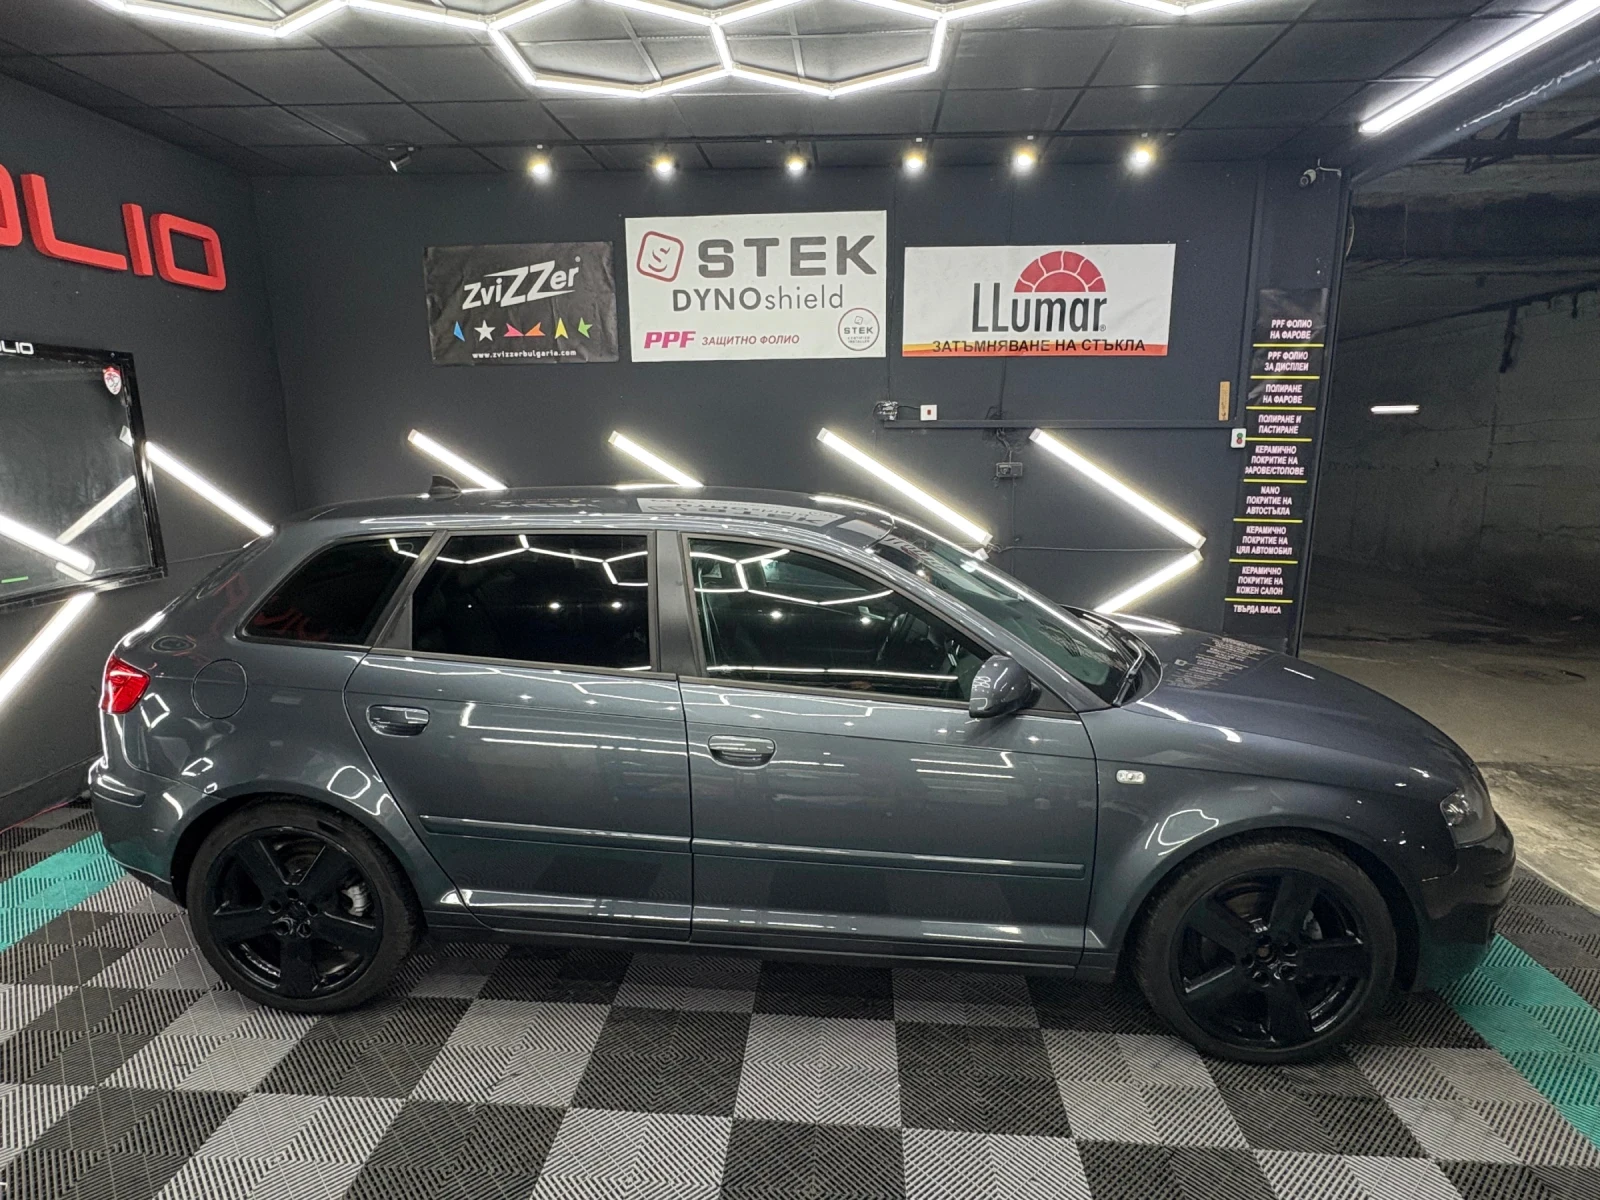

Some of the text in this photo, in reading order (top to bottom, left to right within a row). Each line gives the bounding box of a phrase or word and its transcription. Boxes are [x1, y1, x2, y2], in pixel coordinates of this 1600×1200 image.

[0, 164, 226, 290] LIO
[698, 235, 877, 278] STEK
[672, 284, 843, 311] DYNOshield
[1271, 319, 1312, 329] PPF ФОЛИО
[1270, 330, 1311, 339] НА ФАРОВЕ
[644, 331, 800, 348] PPF ЗАЩИТНО ФОЛИО
[0, 340, 34, 355] LIO
[933, 338, 1146, 352] ЗАТЪМНЯВАНЕ НА СТЪКЛА
[472, 350, 577, 359] www.zvizzerbulgaria.com
[1267, 351, 1308, 360] PPF ФОЛИО
[1264, 362, 1274, 371] ЗА
[1265, 384, 1302, 393] ПОЛИРАНЕ
[1262, 395, 1303, 404] НА ФАРОВЕ
[1258, 414, 1302, 424] ПОЛИРАНЕ И
[1258, 425, 1299, 434] ПАСТИРАНЕ
[1255, 445, 1297, 455] КЕРАМИЧНО
[1251, 455, 1298, 465] ПОКРИТИЕ НА
[1246, 496, 1292, 505] ПОКРИТИЕ НА
[1246, 506, 1290, 515] АВТОСТЪКЛА
[1246, 525, 1287, 534] КЕРАМИЧНО
[1242, 536, 1288, 545] ПОКРИТИЕ НА
[1251, 546, 1293, 555] АВТОМОБИЛ
[1241, 566, 1282, 575] КЕРАМИЧНО
[1237, 576, 1283, 585] ПОКРИТИЕ НА
[1236, 586, 1283, 595] КОЖЕН САЛОН
[1233, 604, 1282, 614] ТВЪРДА ВАКСА
